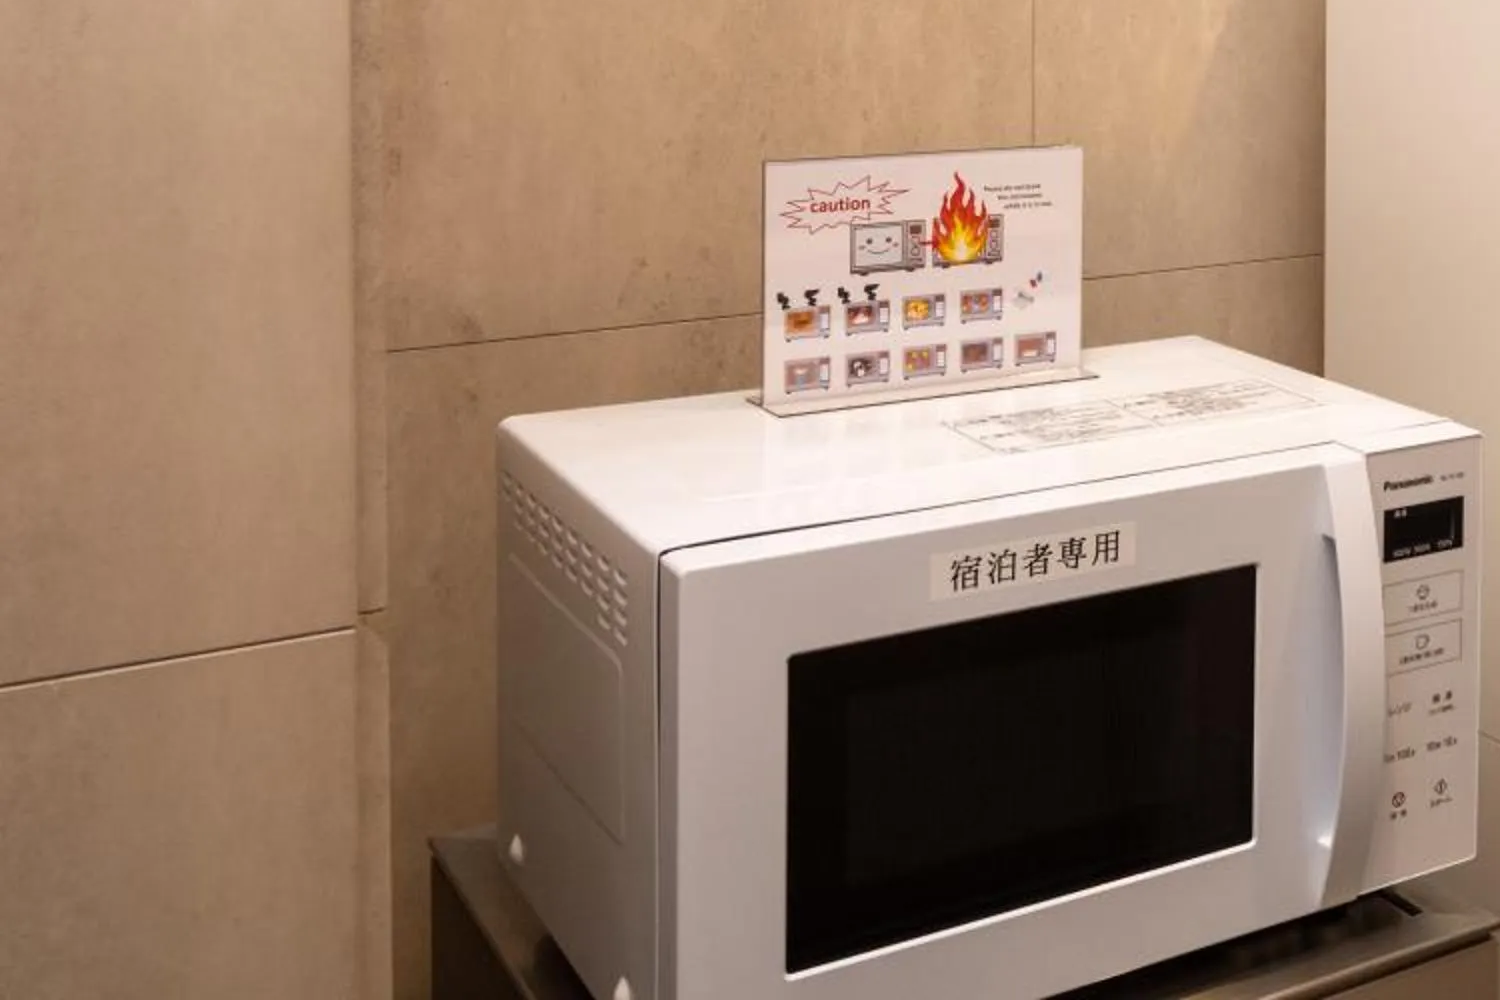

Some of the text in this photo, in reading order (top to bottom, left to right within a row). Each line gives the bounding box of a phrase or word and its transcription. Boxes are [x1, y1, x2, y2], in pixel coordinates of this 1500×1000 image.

[809, 196, 871, 214] caution
[950, 530, 1120, 592] 宿泊者専用
